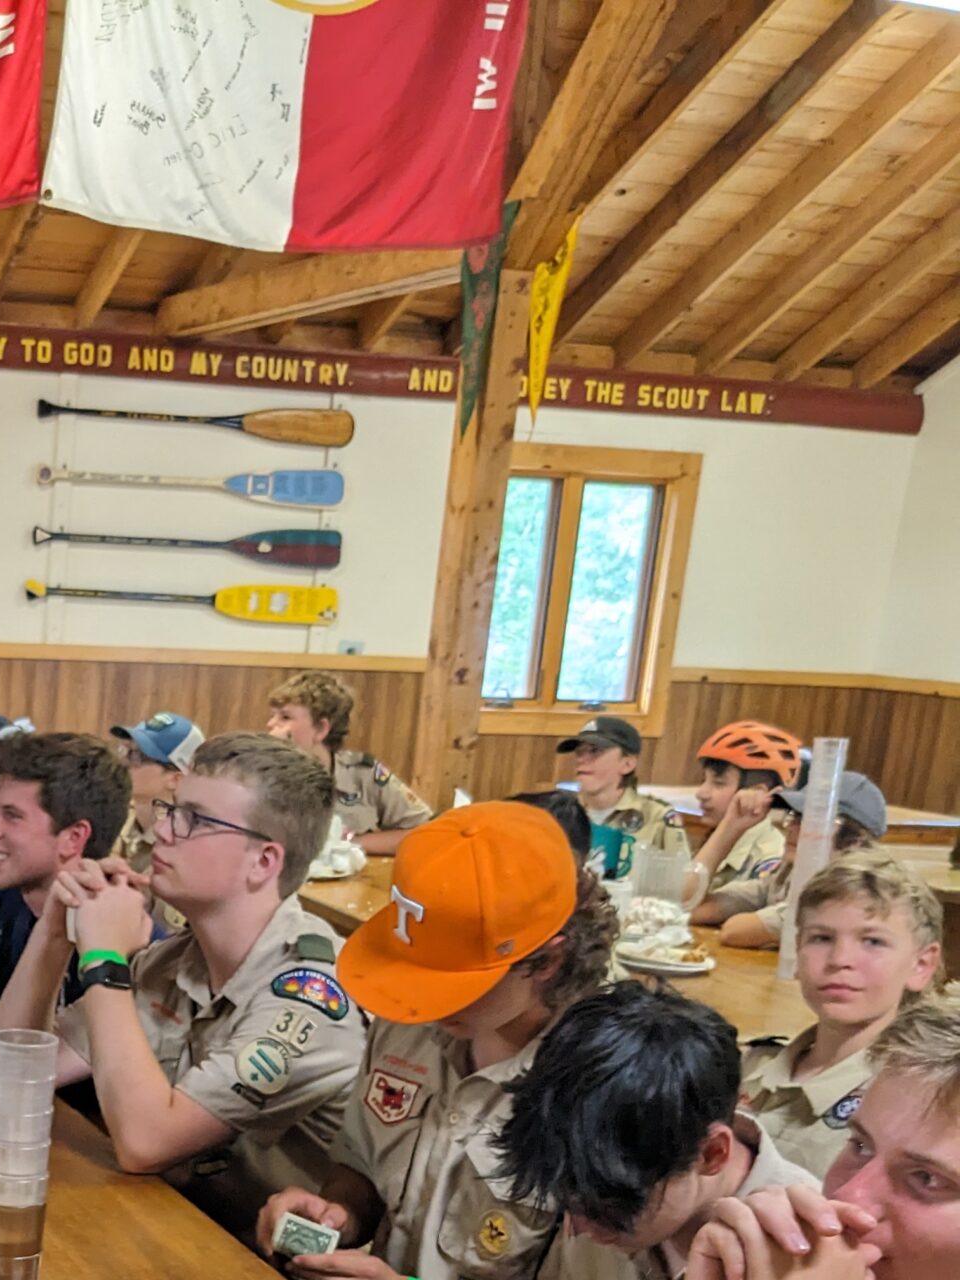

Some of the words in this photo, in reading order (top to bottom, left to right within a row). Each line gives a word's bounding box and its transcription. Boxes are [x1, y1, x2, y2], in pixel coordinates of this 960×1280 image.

[21, 338, 52, 363] TO
[64, 342, 112, 367] GOD
[128, 347, 175, 373] AND
[189, 352, 223, 377] MY
[408, 367, 454, 393] AND
[583, 379, 625, 406] THE
[637, 385, 710, 410] SCOUT
